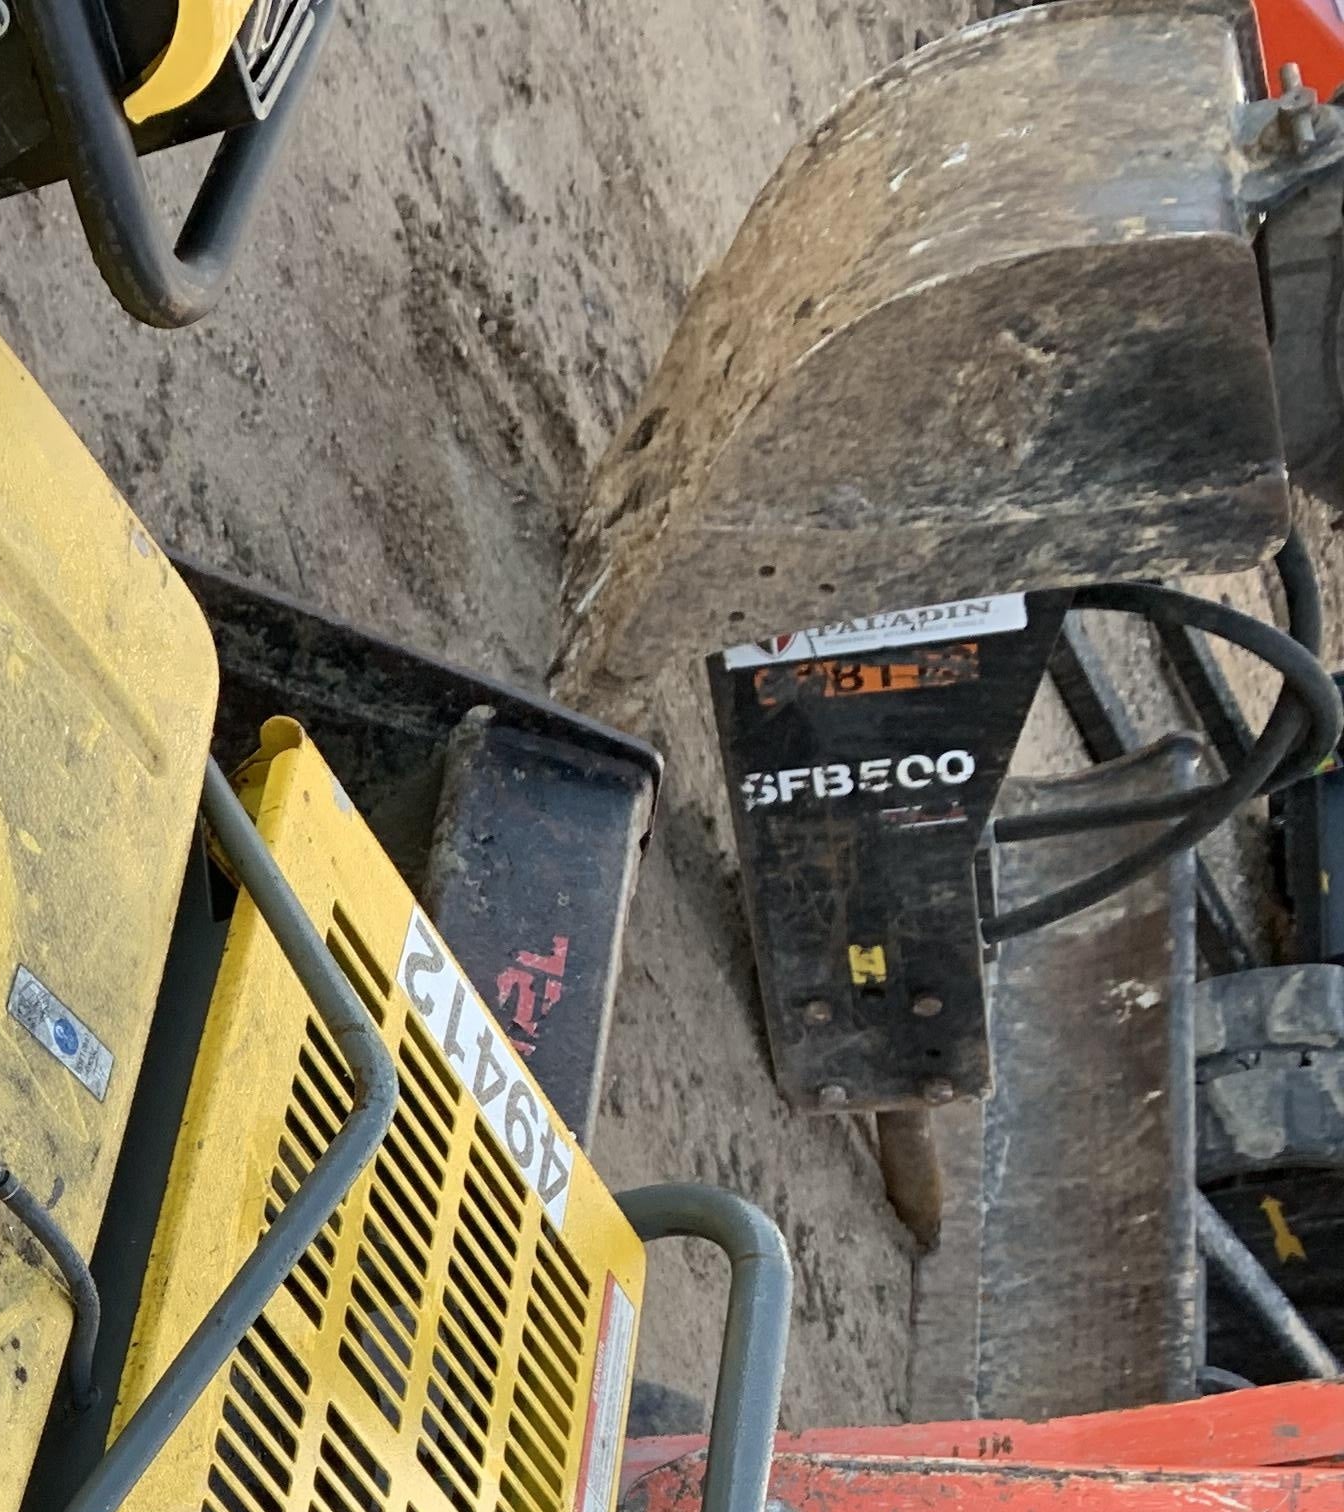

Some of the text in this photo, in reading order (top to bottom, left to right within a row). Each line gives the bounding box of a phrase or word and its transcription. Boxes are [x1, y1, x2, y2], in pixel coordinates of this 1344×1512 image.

[809, 598, 994, 638] PALADIN
[741, 748, 977, 812] SFB500
[403, 918, 569, 1205] 49412
